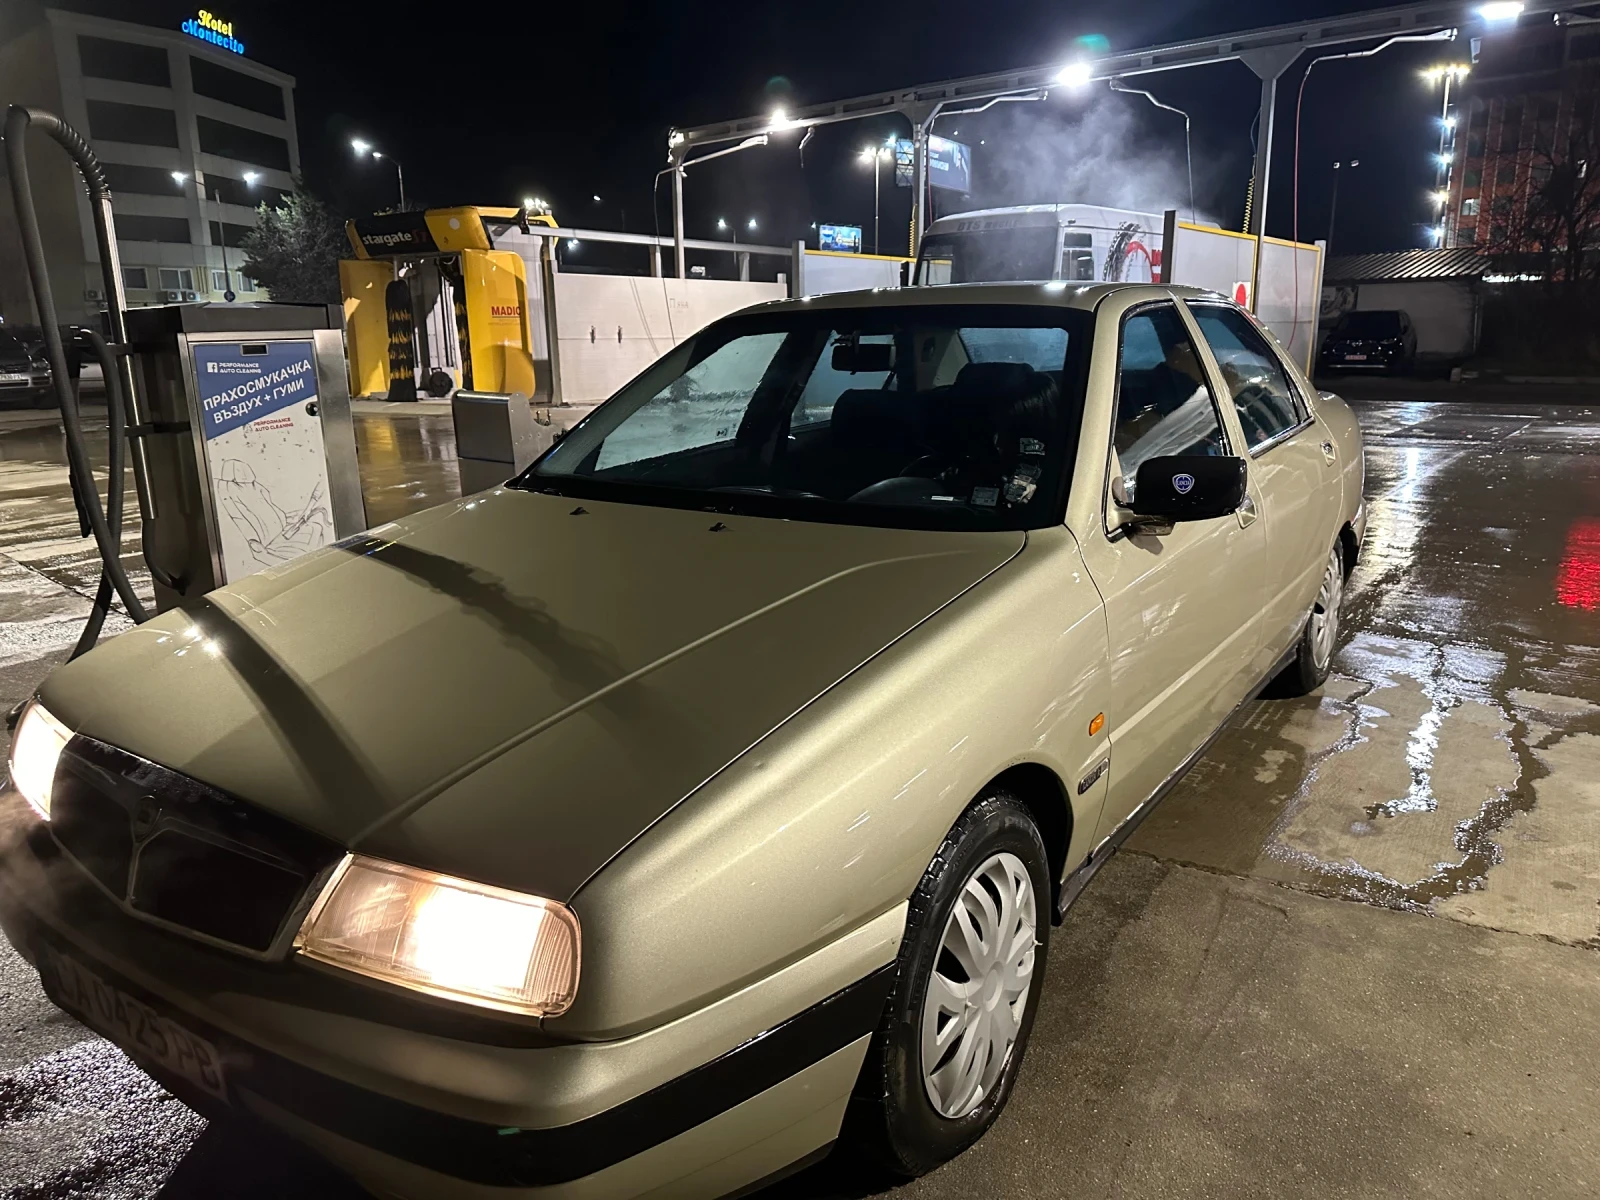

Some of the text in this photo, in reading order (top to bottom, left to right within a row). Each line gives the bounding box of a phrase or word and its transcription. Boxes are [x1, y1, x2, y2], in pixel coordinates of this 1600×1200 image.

[181, 18, 245, 54] Montecito
[198, 9, 233, 37] Hotel
[362, 231, 412, 247] stargate
[203, 359, 312, 411] ПРАХОСМУКАЧКА
[213, 378, 305, 424] ВЪЗДУХ + ГУМИ
[253, 417, 291, 426] PERFORMANCE
[270, 422, 294, 430] CLEANING
